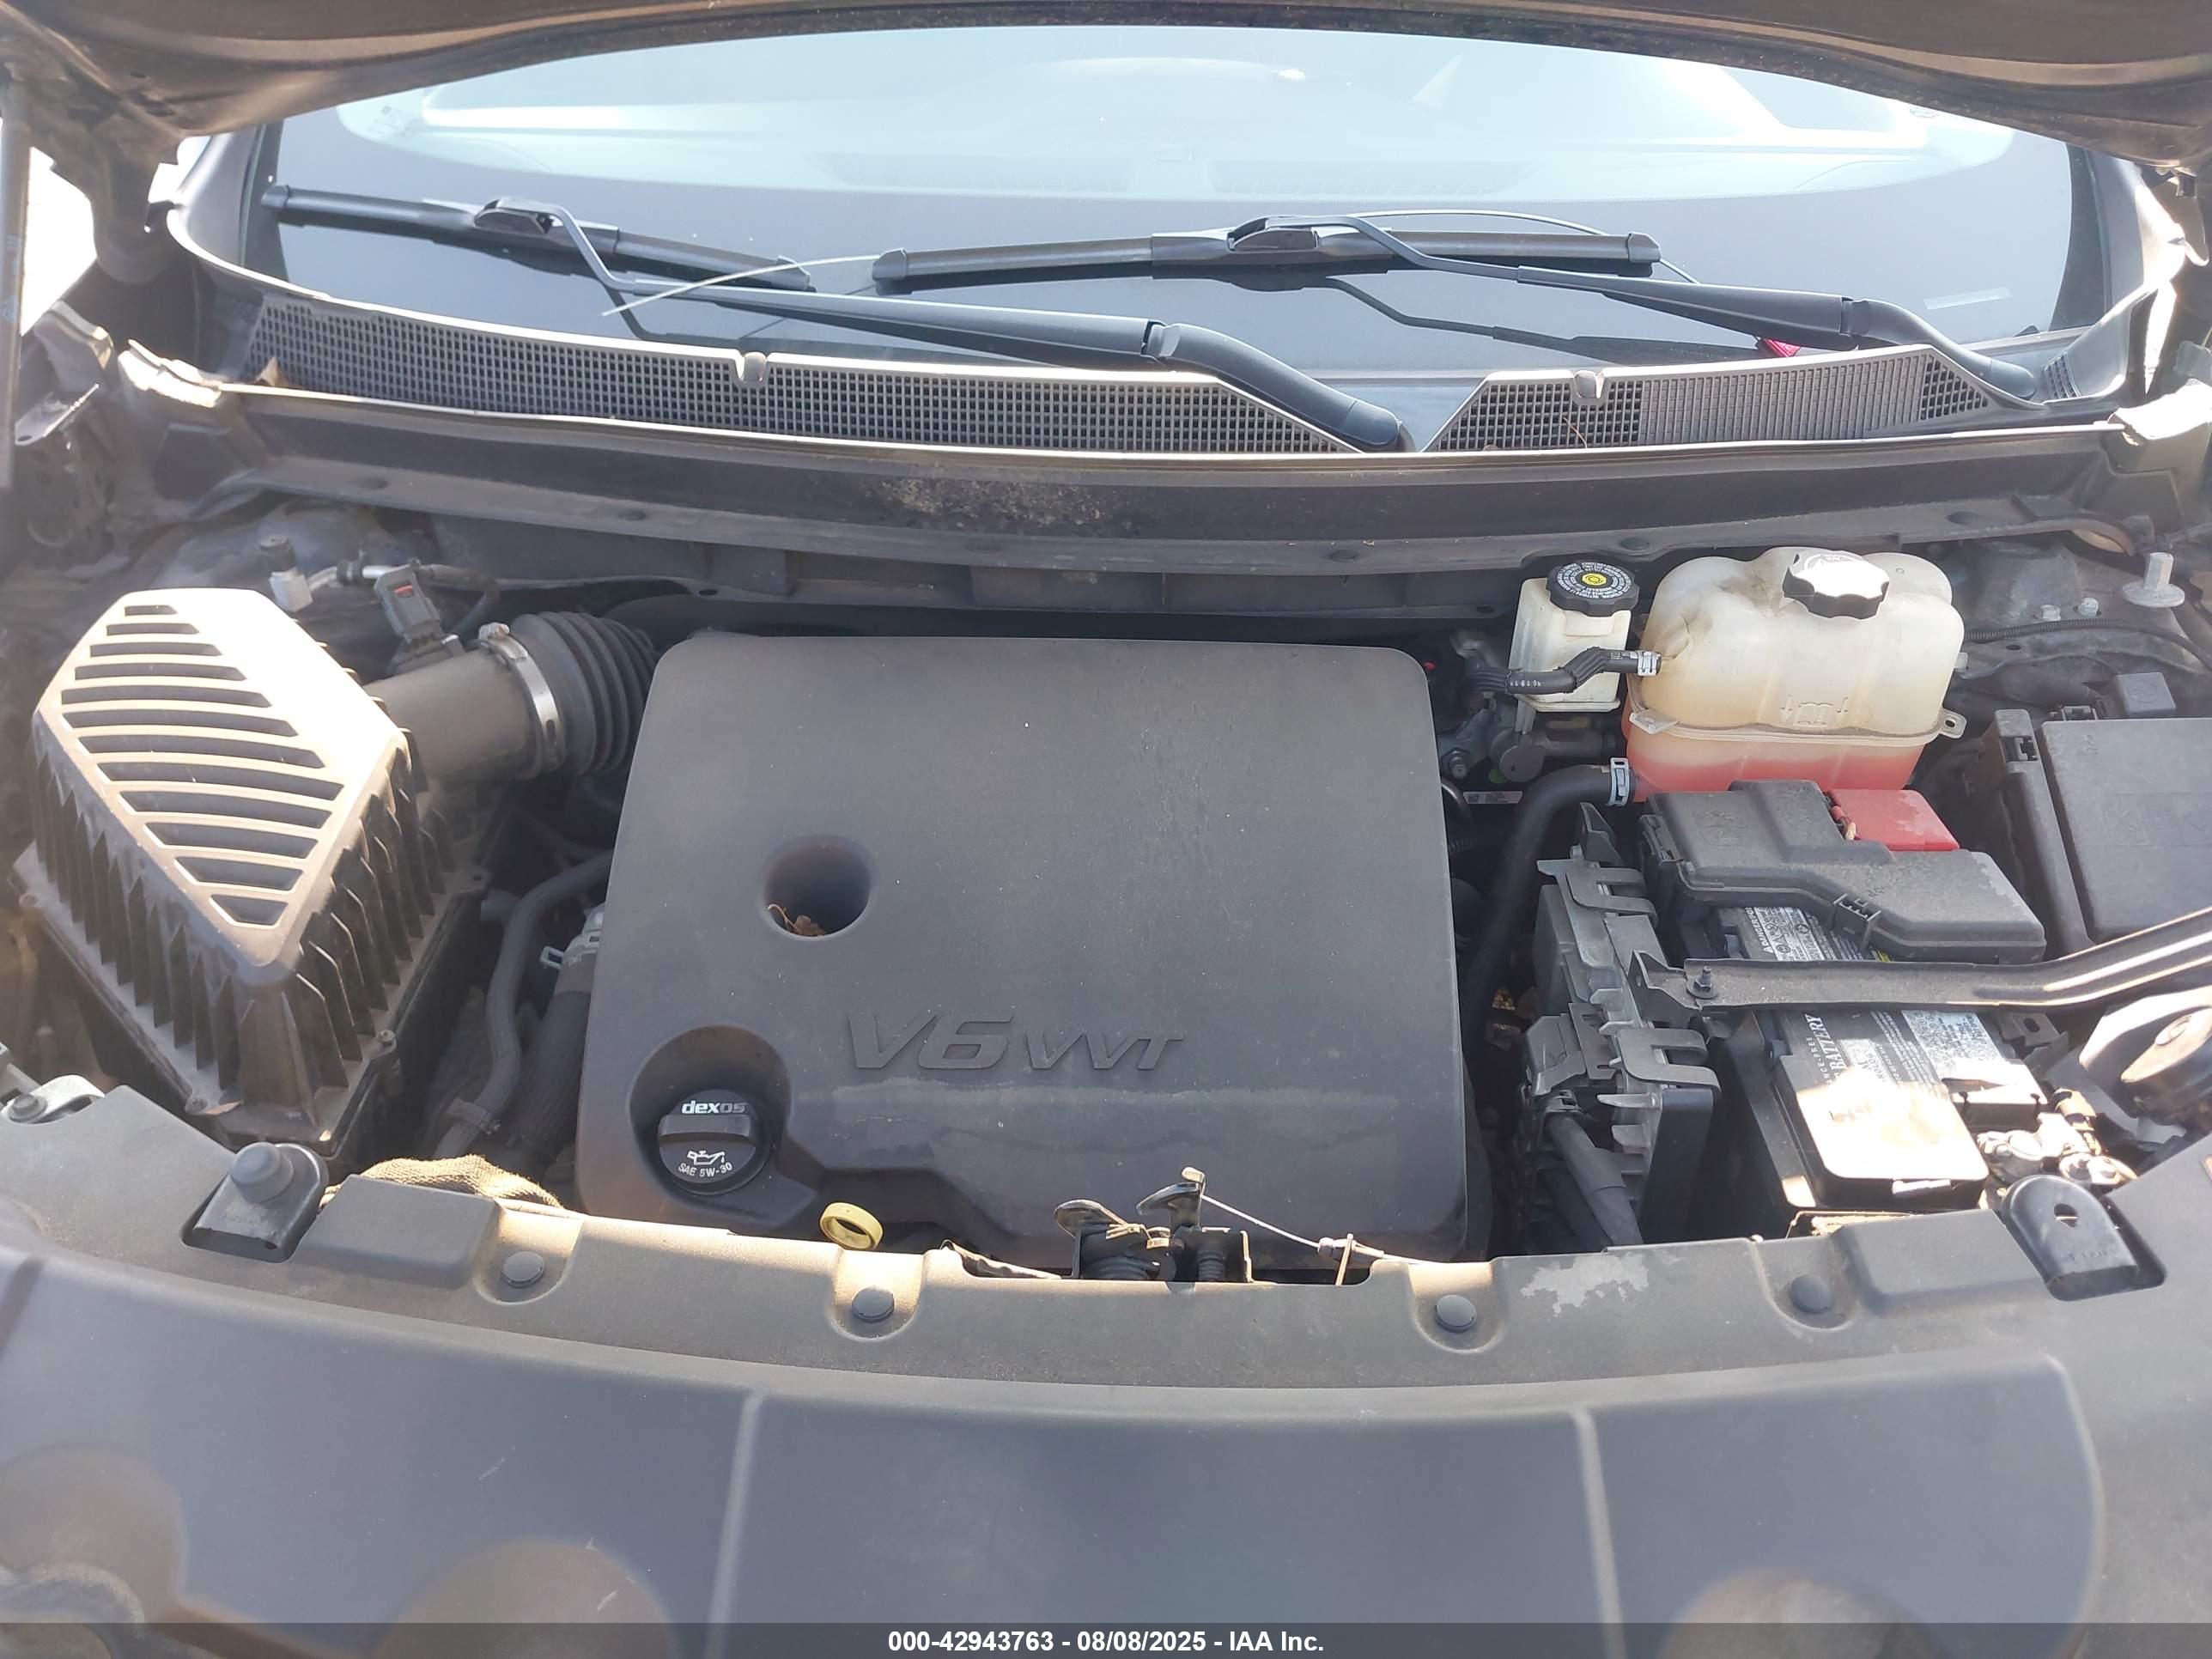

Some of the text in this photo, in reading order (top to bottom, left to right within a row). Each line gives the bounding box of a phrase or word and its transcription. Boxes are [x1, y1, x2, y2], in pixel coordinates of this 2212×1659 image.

[847, 1012, 1183, 1070] V6 VVT
[1804, 1013, 1848, 1070] BATTERY
[681, 1100, 749, 1115] dexos
[678, 1161, 733, 1178] SAE 5W-30
